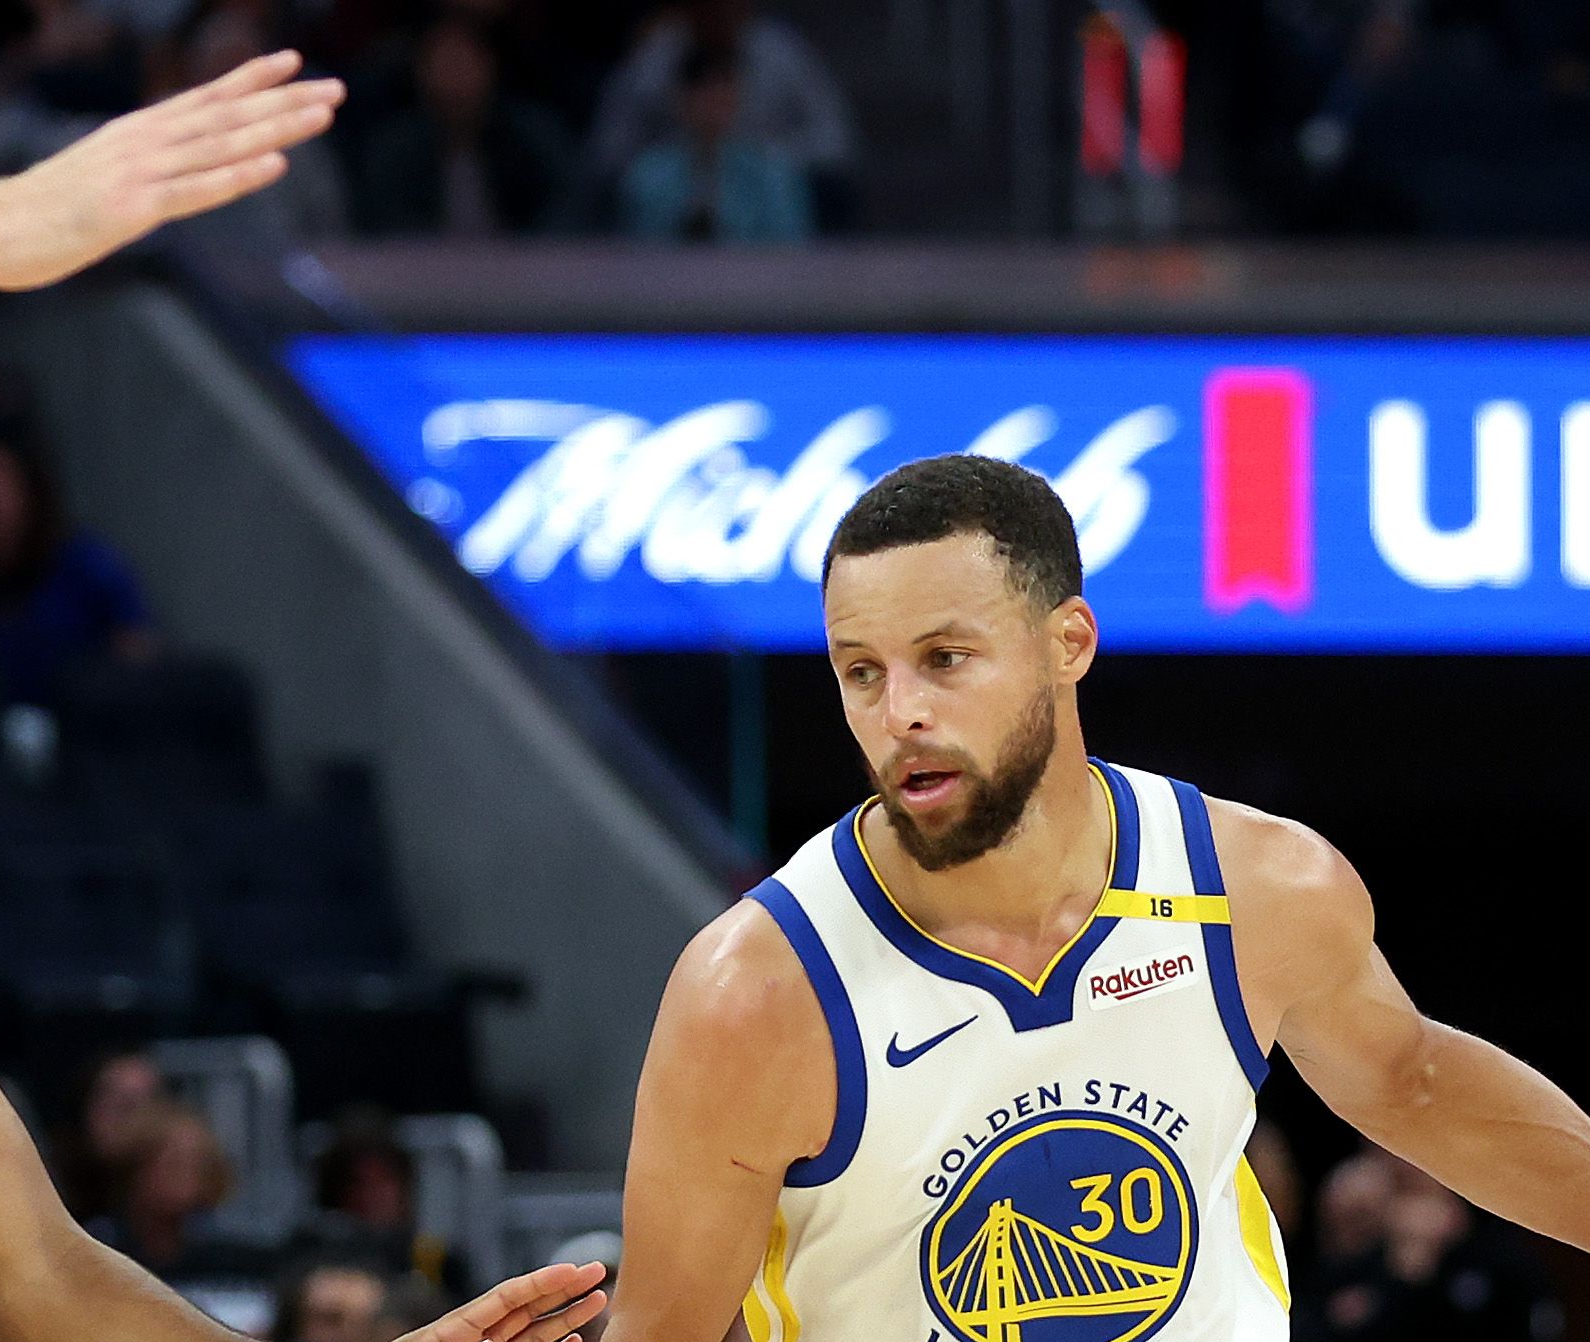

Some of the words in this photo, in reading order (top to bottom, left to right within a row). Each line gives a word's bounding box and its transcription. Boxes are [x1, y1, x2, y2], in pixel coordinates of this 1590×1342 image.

[1150, 897, 1173, 918] 16
[1090, 955, 1194, 1001] Rakuten
[922, 1082, 1063, 1199] GOLDEN
[1084, 1079, 1191, 1142] STATE
[1069, 1167, 1164, 1243] 30
